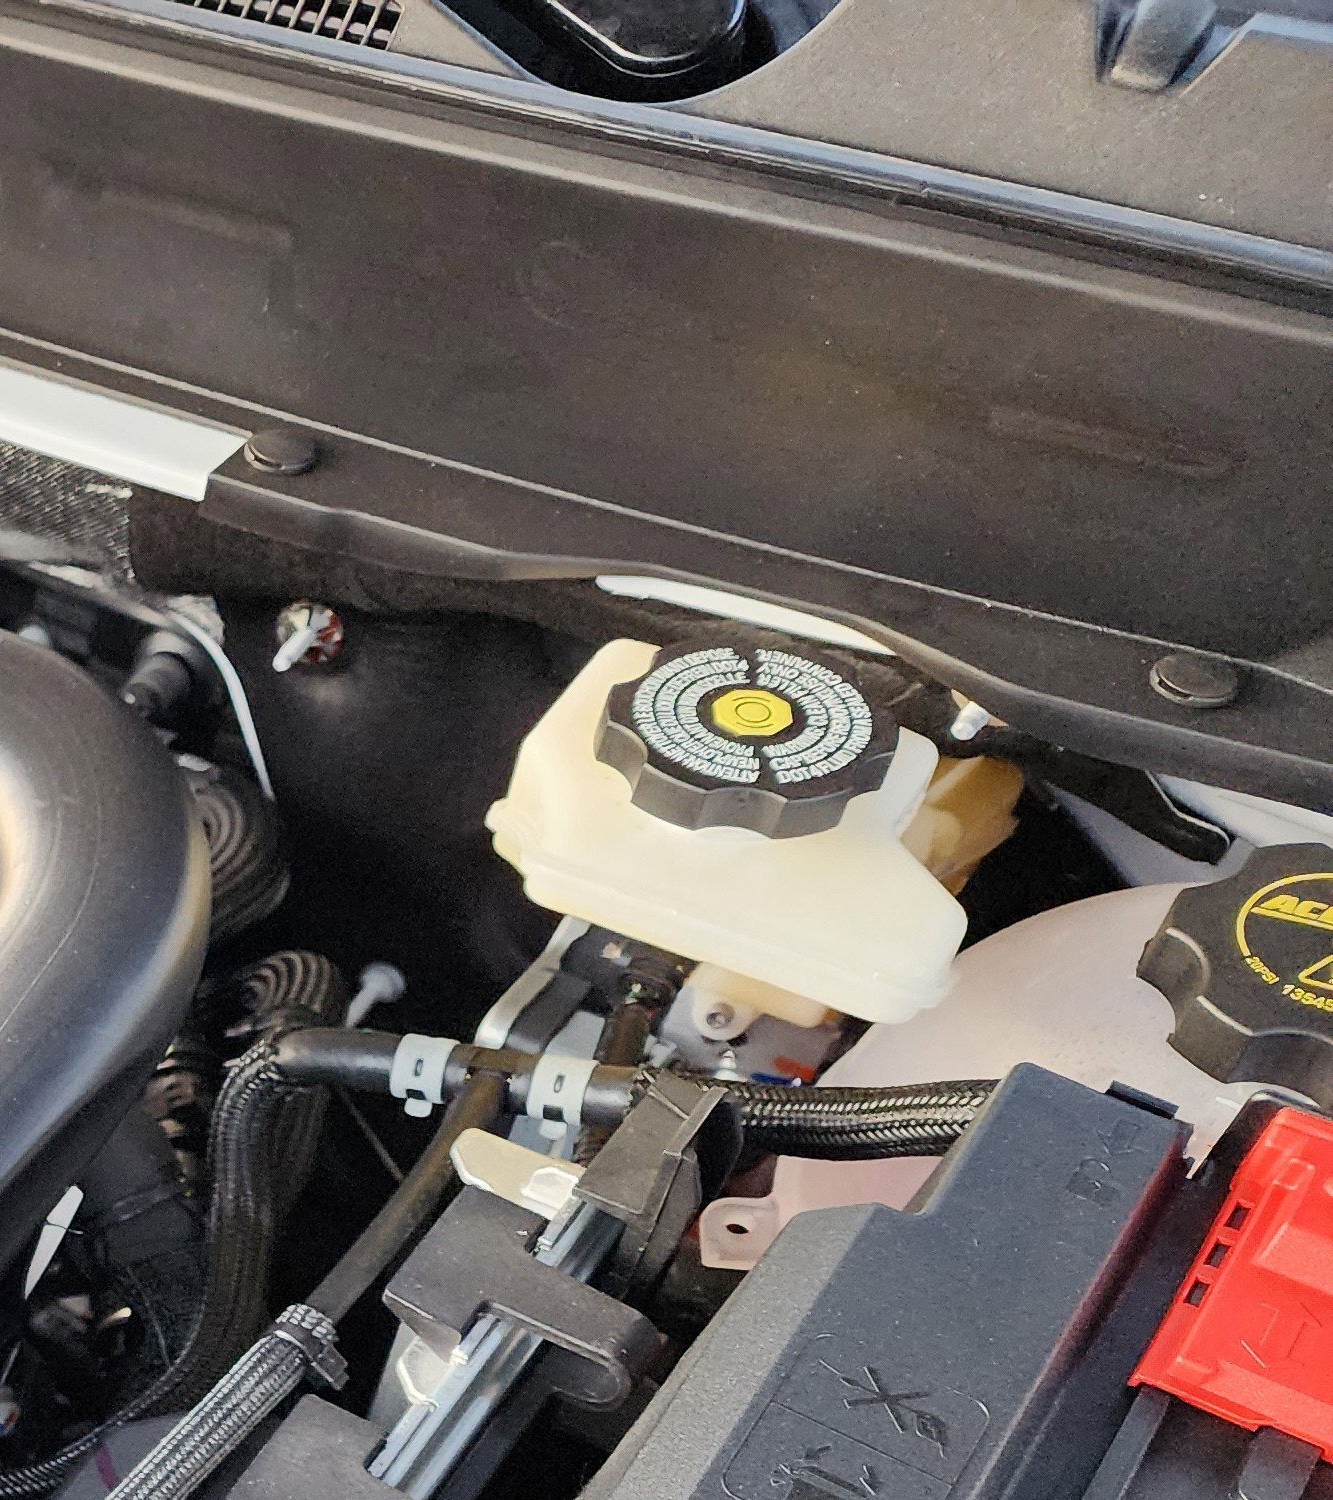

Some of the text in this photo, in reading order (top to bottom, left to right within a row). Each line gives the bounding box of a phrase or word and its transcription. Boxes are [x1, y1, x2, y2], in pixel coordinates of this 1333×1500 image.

[755, 661, 803, 681] ONLY
[793, 672, 829, 693] USE
[755, 672, 812, 699] FILLER
[830, 680, 872, 718] SEALED
[794, 692, 828, 727] CLEAN
[681, 722, 755, 756] PROVENANT
[794, 731, 847, 764] BEFORE
[840, 724, 872, 754] FROM
[766, 753, 806, 771] CAP
[812, 747, 859, 774] FLUID
